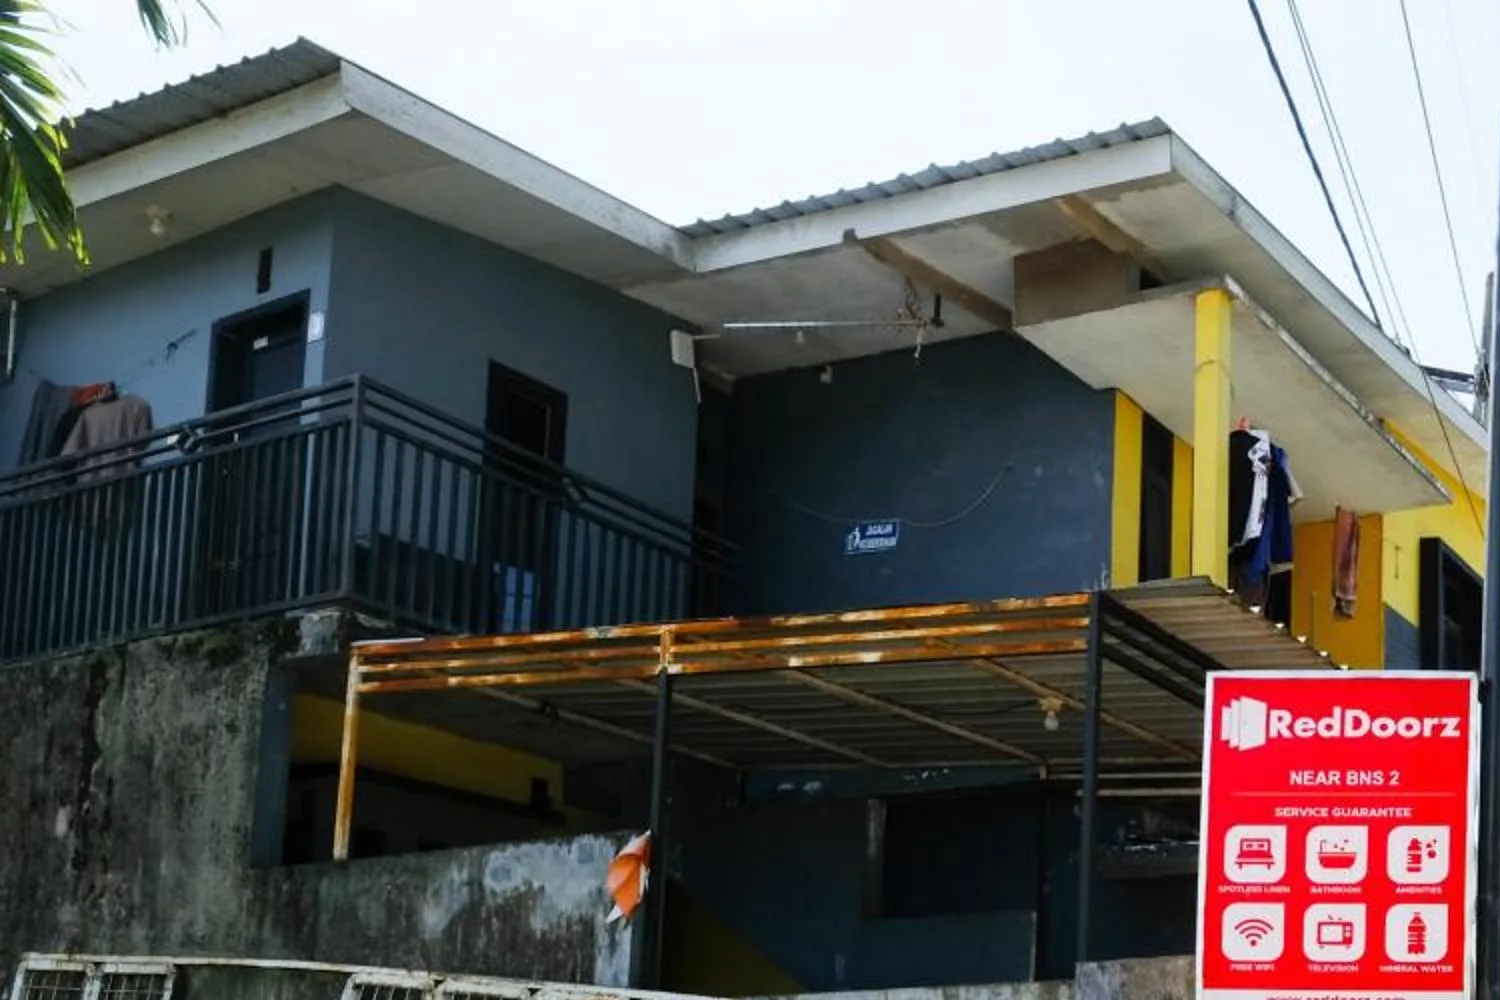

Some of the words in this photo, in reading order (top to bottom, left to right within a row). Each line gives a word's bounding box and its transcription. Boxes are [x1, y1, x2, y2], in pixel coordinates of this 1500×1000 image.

[1269, 705, 1462, 739] RedDoorz
[1289, 769, 1341, 785] NEAR
[1345, 769, 1385, 785] BNS
[1388, 769, 1400, 785] 2
[1274, 806, 1329, 817] SERVICE
[1332, 807, 1413, 818] GUARANTEE
